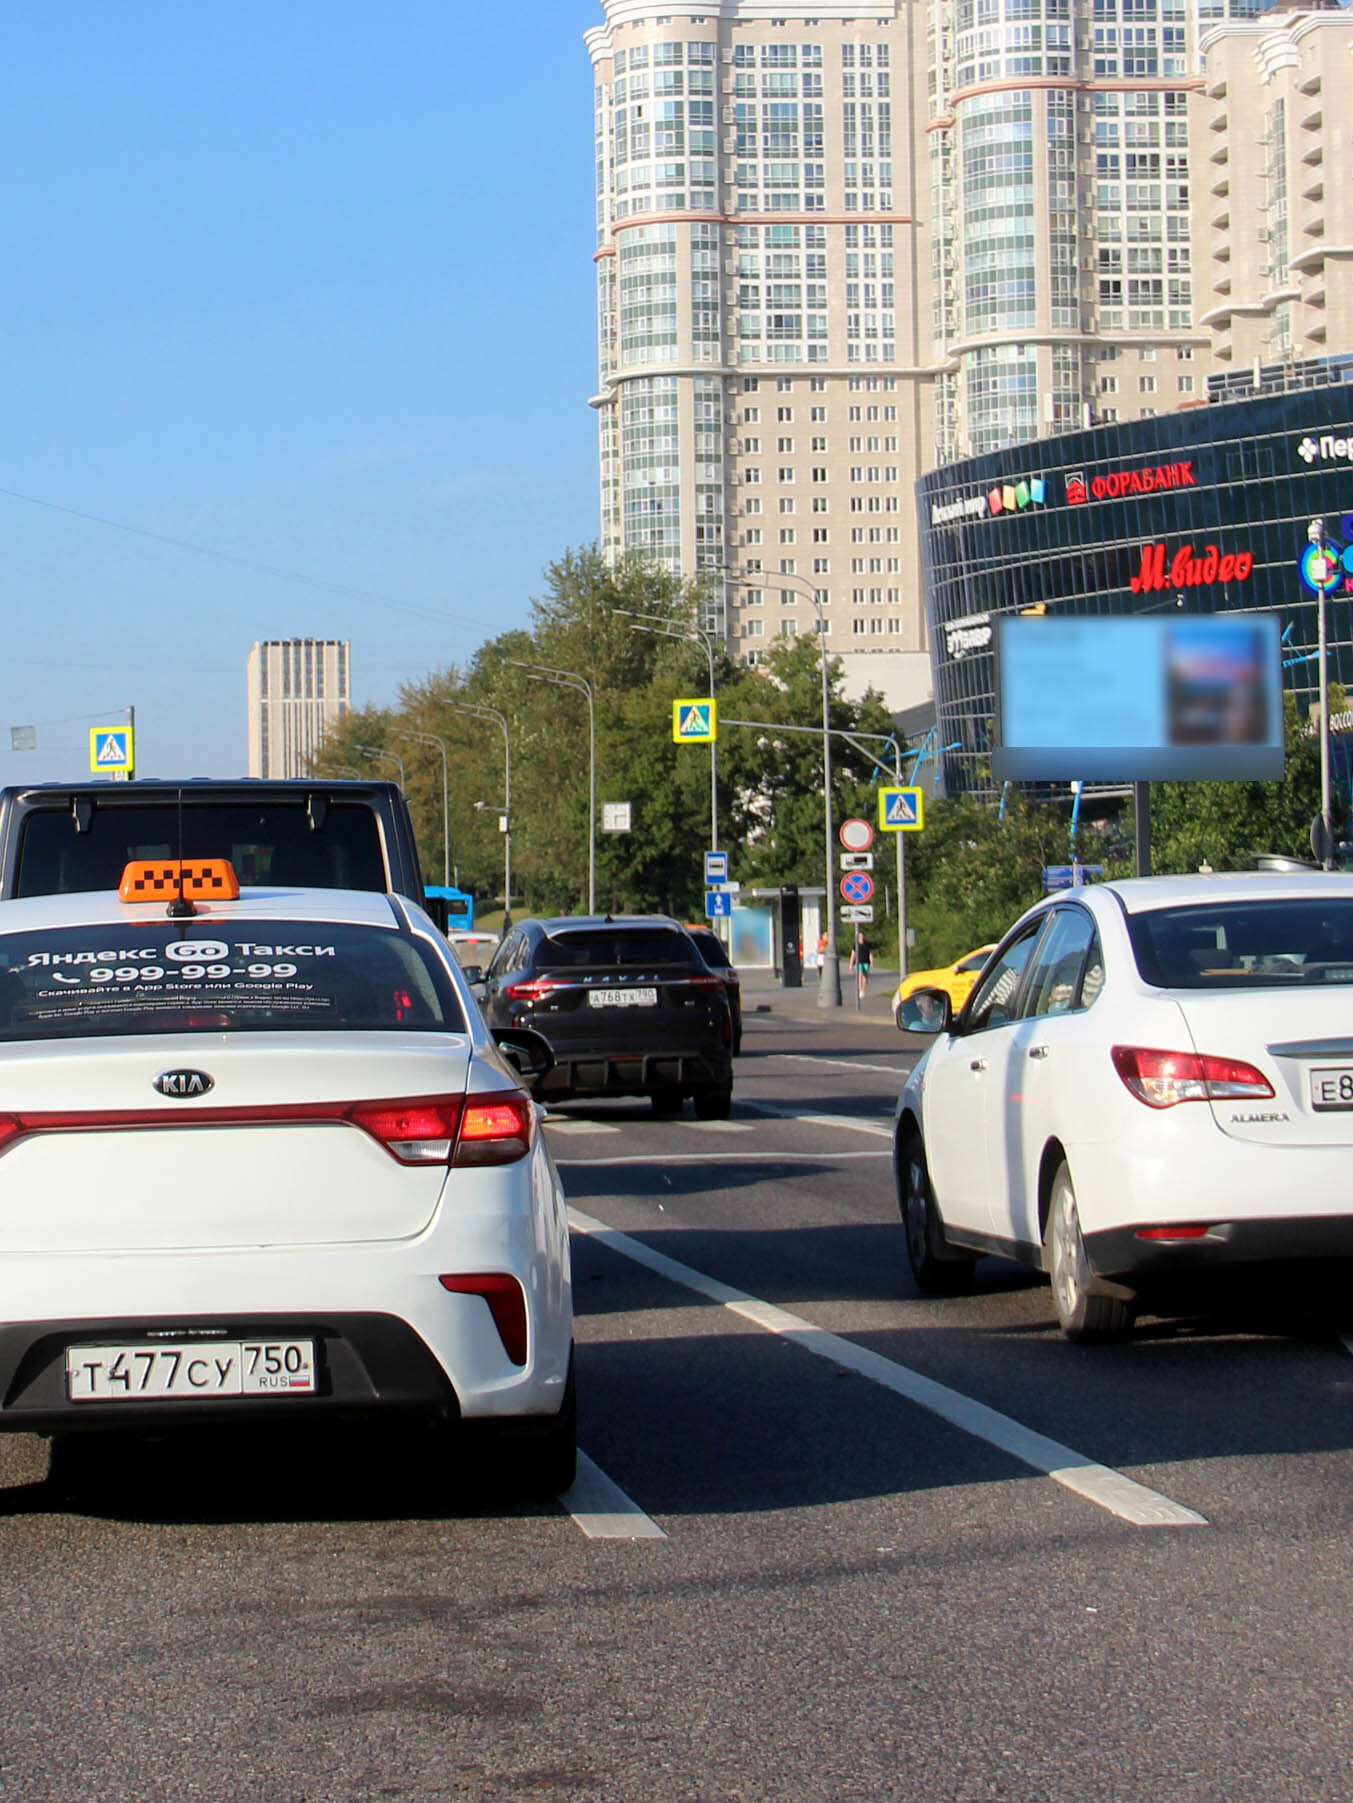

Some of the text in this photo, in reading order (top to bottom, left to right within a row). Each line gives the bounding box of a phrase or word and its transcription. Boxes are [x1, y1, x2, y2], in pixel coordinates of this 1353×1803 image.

[1091, 461, 1196, 499] ФОРАБАНК
[1130, 543, 1254, 595] М.видео
[28, 943, 335, 967] Яндекс Go Такси
[89, 963, 298, 982] 999-99-99
[38, 985, 121, 998] Скачивайте
[134, 983, 163, 993] App
[165, 982, 202, 991] Store
[234, 982, 283, 992] Google
[286, 982, 314, 992] Play
[162, 1074, 204, 1093] KIA
[1230, 1112, 1291, 1124] ALMERA
[82, 1345, 303, 1393] Т477СУ 750
[259, 1376, 289, 1388] RUS
